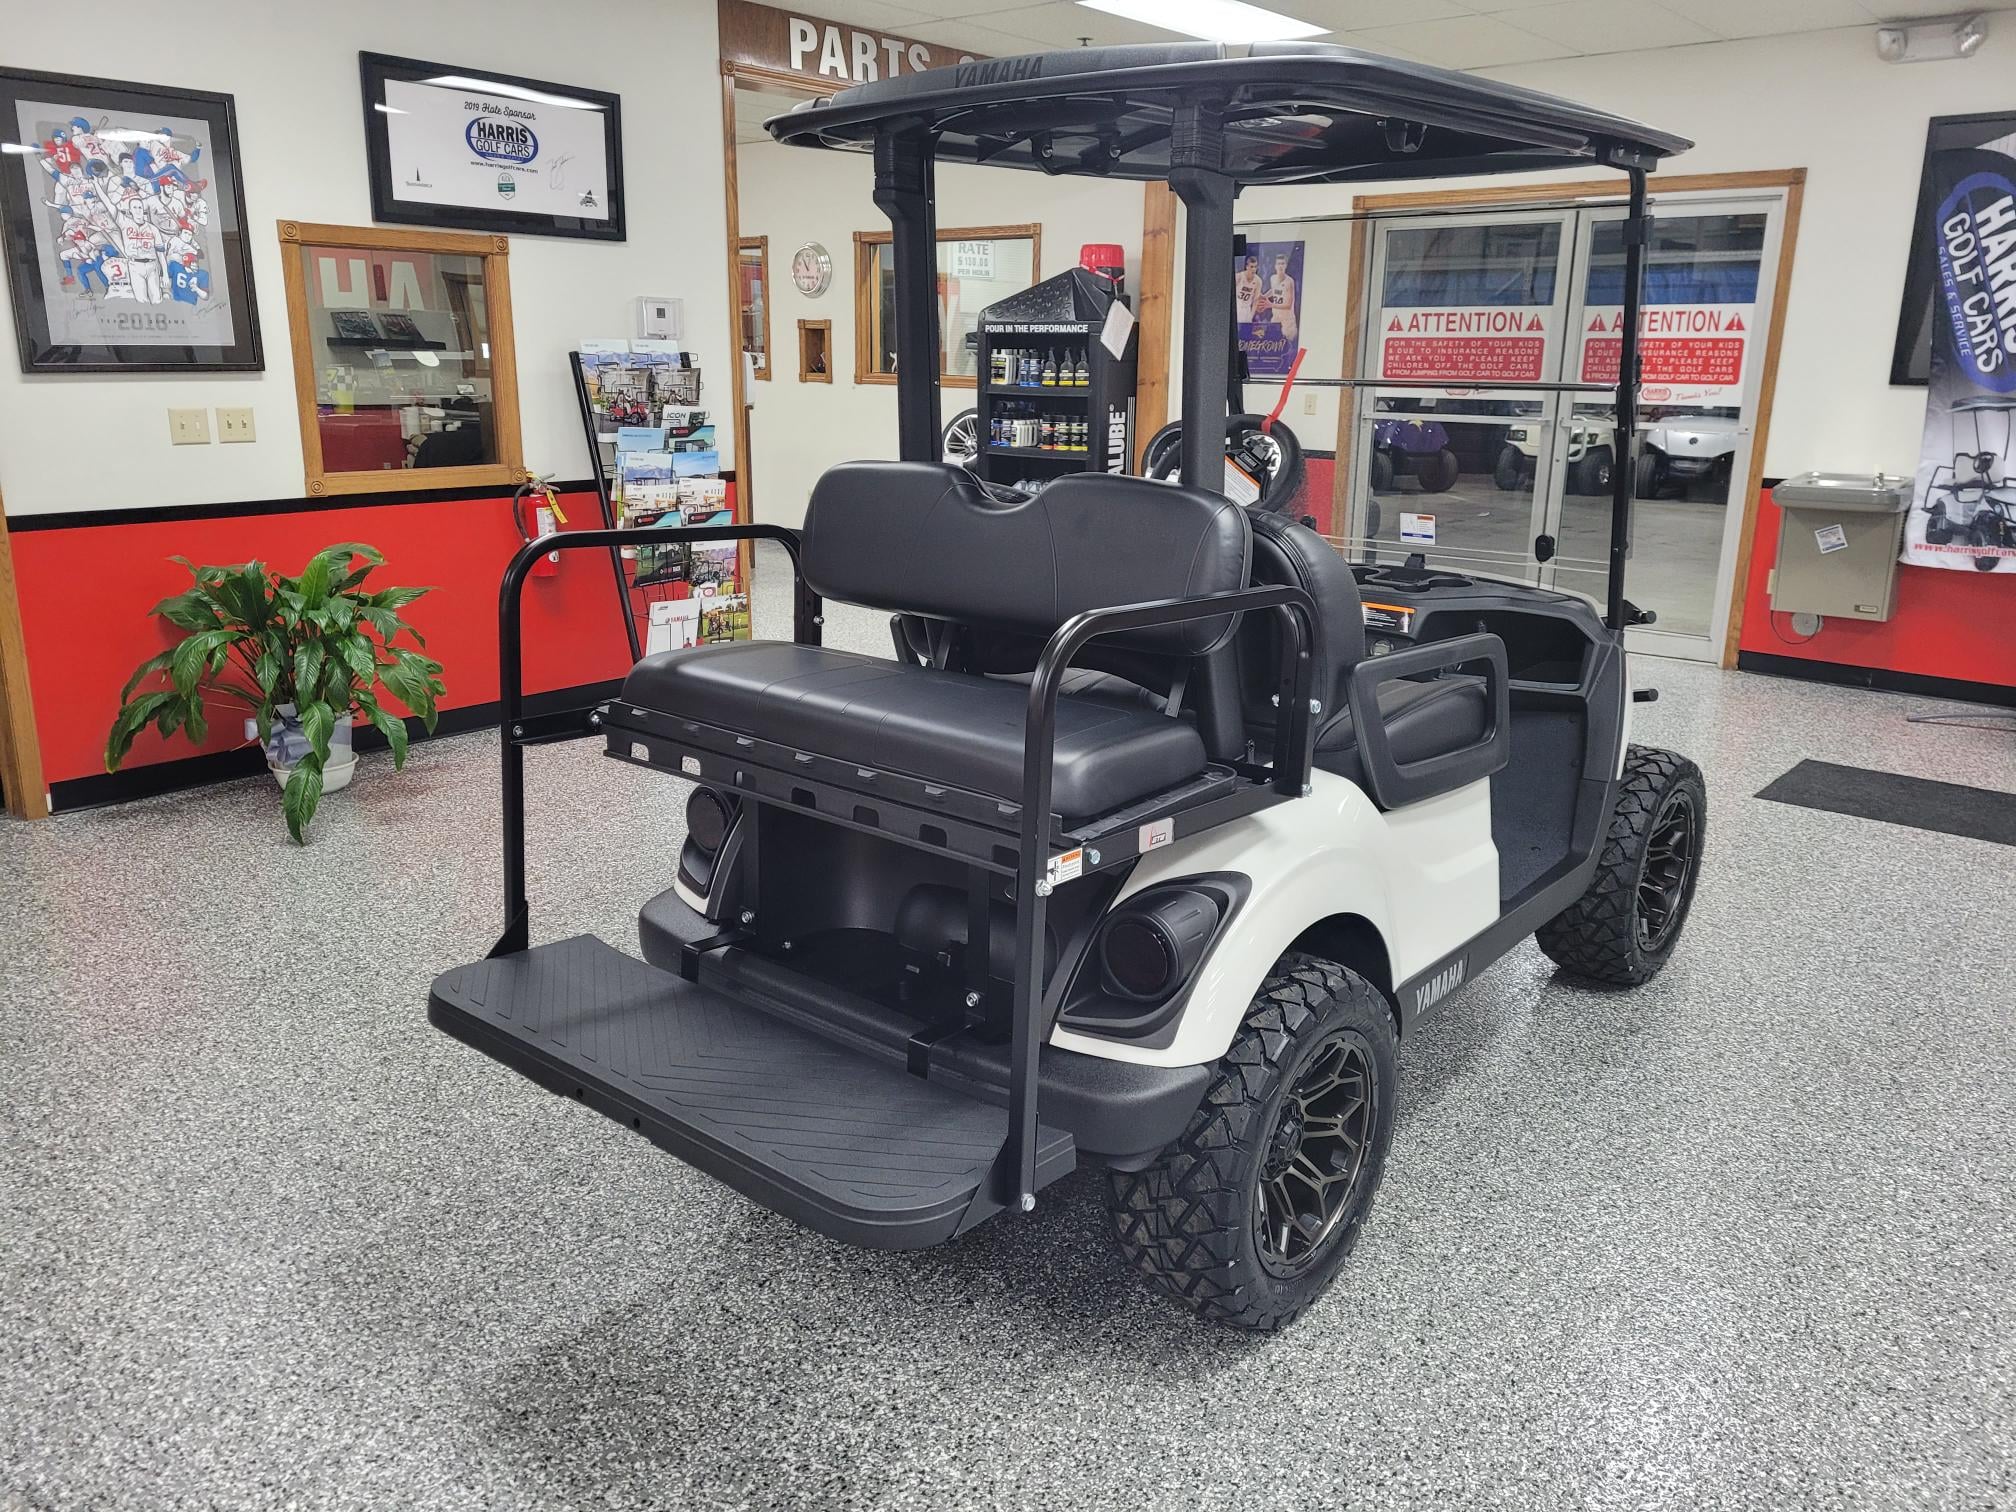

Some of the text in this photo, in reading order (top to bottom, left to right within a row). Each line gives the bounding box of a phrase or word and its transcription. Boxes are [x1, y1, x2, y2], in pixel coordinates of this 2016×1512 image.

[789, 17, 931, 82] PARTS
[954, 56, 1044, 88] YAMAHA
[464, 101, 480, 111] 2019
[503, 106, 537, 120] Sponsor
[477, 121, 528, 144] HARRIS
[57, 148, 71, 162] 51
[476, 139, 501, 153] GOLF
[504, 142, 530, 157] CARS
[470, 160, 538, 174] www.harrisgolfcars.com
[958, 243, 989, 256] RATE
[110, 264, 123, 278] 3
[1238, 292, 1251, 302] 30
[1938, 246, 1954, 287] SALES
[1951, 304, 1972, 357] SERVICE
[1943, 212, 2003, 373] GOLF CARS
[117, 312, 168, 331] 2018
[985, 324, 1089, 333] POUR IN THE PERFORMANCE
[1407, 312, 1523, 333] ATTENTION
[1611, 311, 1721, 332] ATENTION
[666, 411, 687, 419] ICON
[1416, 960, 1463, 1015] YAMAHA
